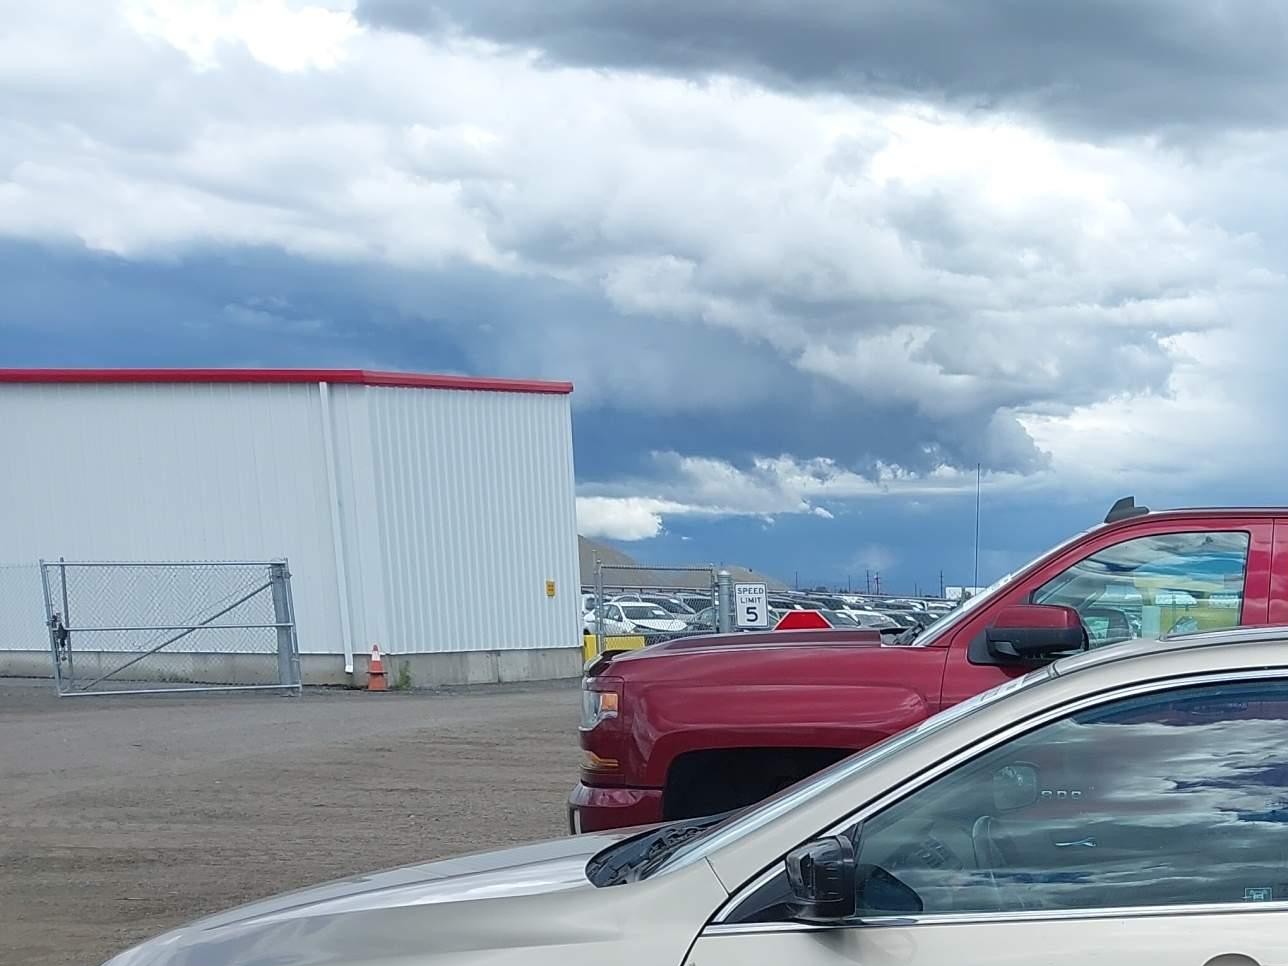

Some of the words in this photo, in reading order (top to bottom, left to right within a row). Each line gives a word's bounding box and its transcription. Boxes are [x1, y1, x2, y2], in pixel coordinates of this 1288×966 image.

[737, 587, 764, 595] SPEED
[740, 596, 762, 604] LIMIT
[746, 606, 759, 622] 5
